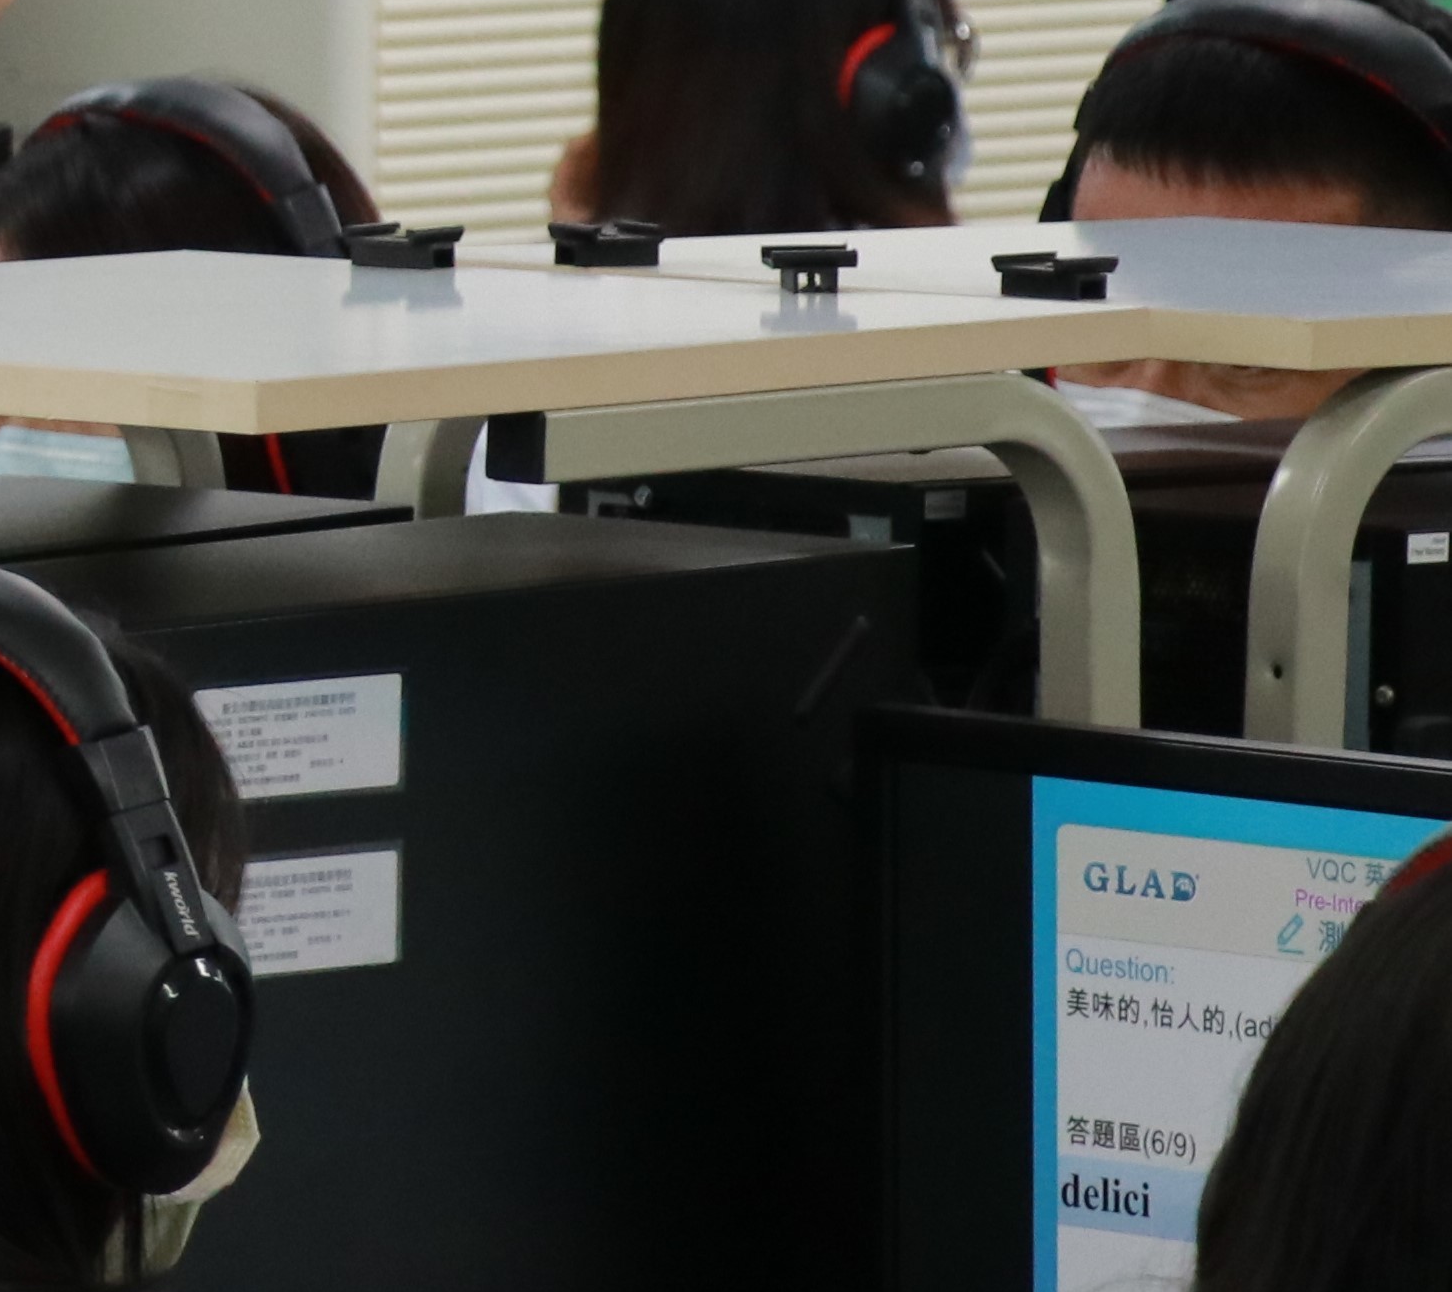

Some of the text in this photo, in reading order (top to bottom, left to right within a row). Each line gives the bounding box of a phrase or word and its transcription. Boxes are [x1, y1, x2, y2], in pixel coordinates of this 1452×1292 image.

[1083, 862, 1198, 903] GLAD
[1306, 857, 1357, 885] VQC
[162, 871, 201, 939] kworld
[1066, 947, 1176, 985] Question:
[1066, 1115, 1197, 1164] 答題區(6/9)
[1060, 1173, 1151, 1218] delici
